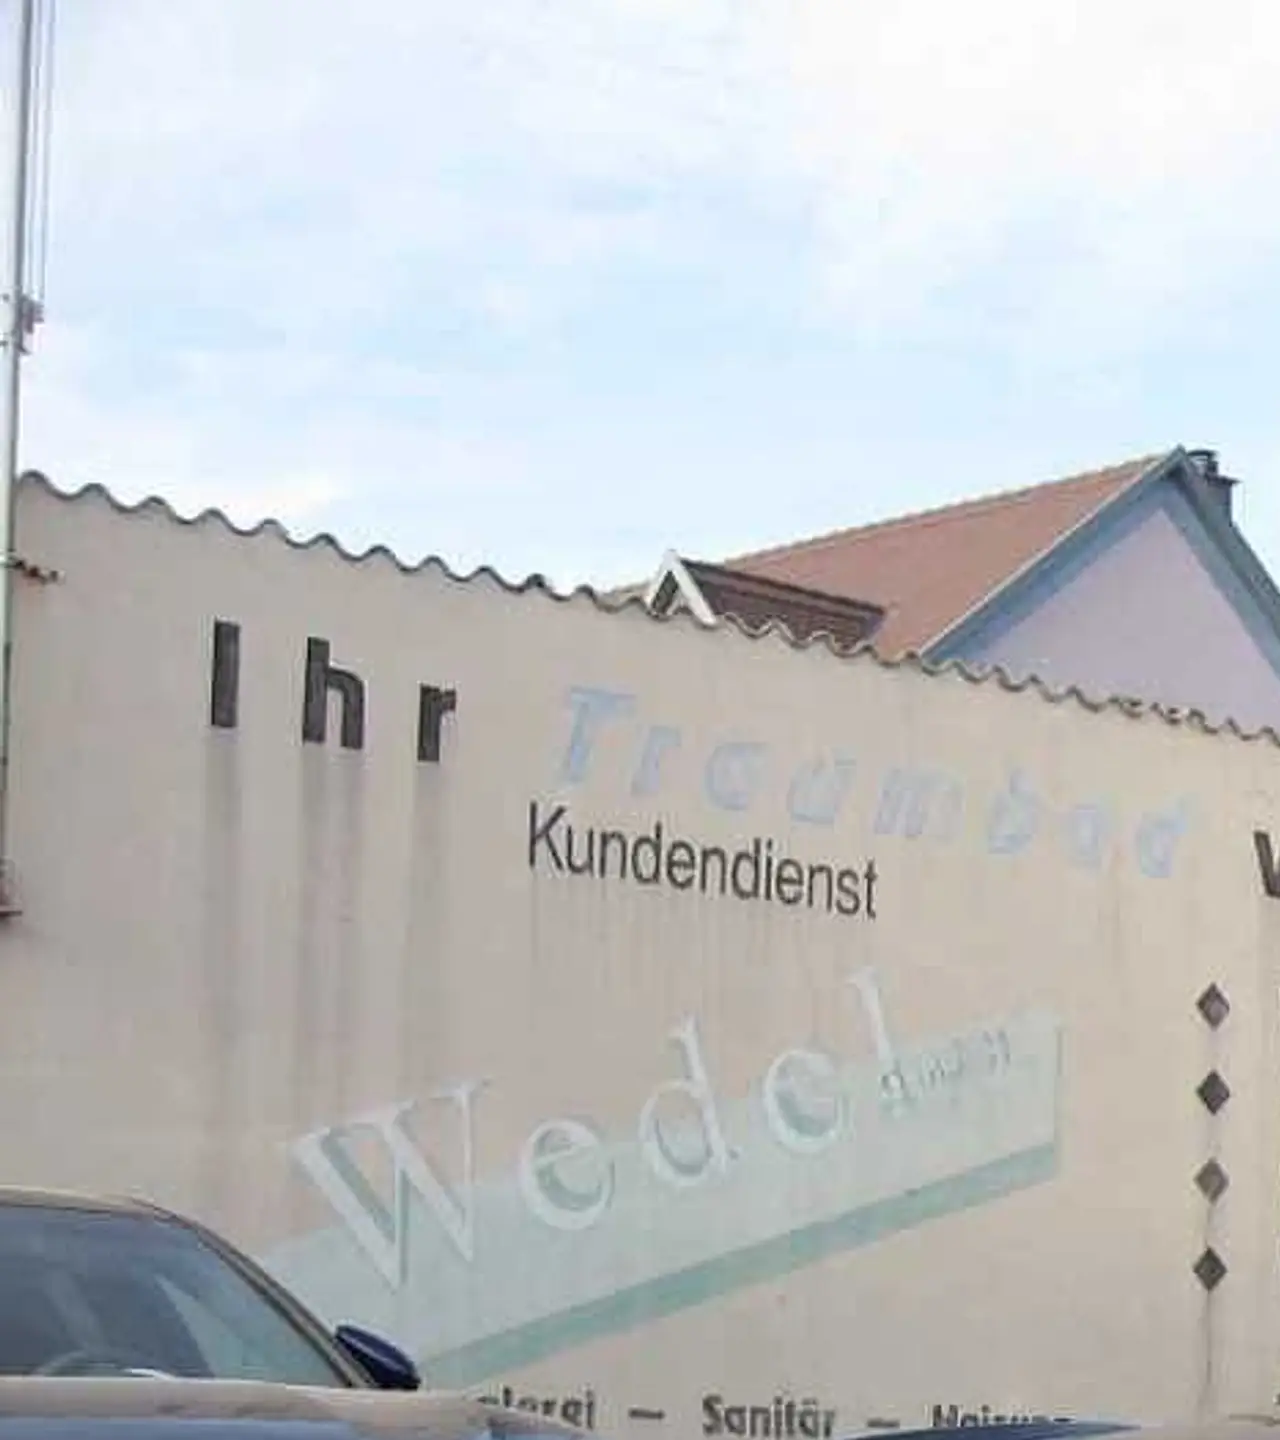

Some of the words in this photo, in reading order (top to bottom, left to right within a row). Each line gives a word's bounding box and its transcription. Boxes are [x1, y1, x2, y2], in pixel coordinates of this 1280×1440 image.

[211, 619, 457, 762] Ihr
[529, 800, 879, 918] Kundendienst
[291, 965, 896, 1295] Wedel
[702, 1393, 836, 1440] Sanitär
